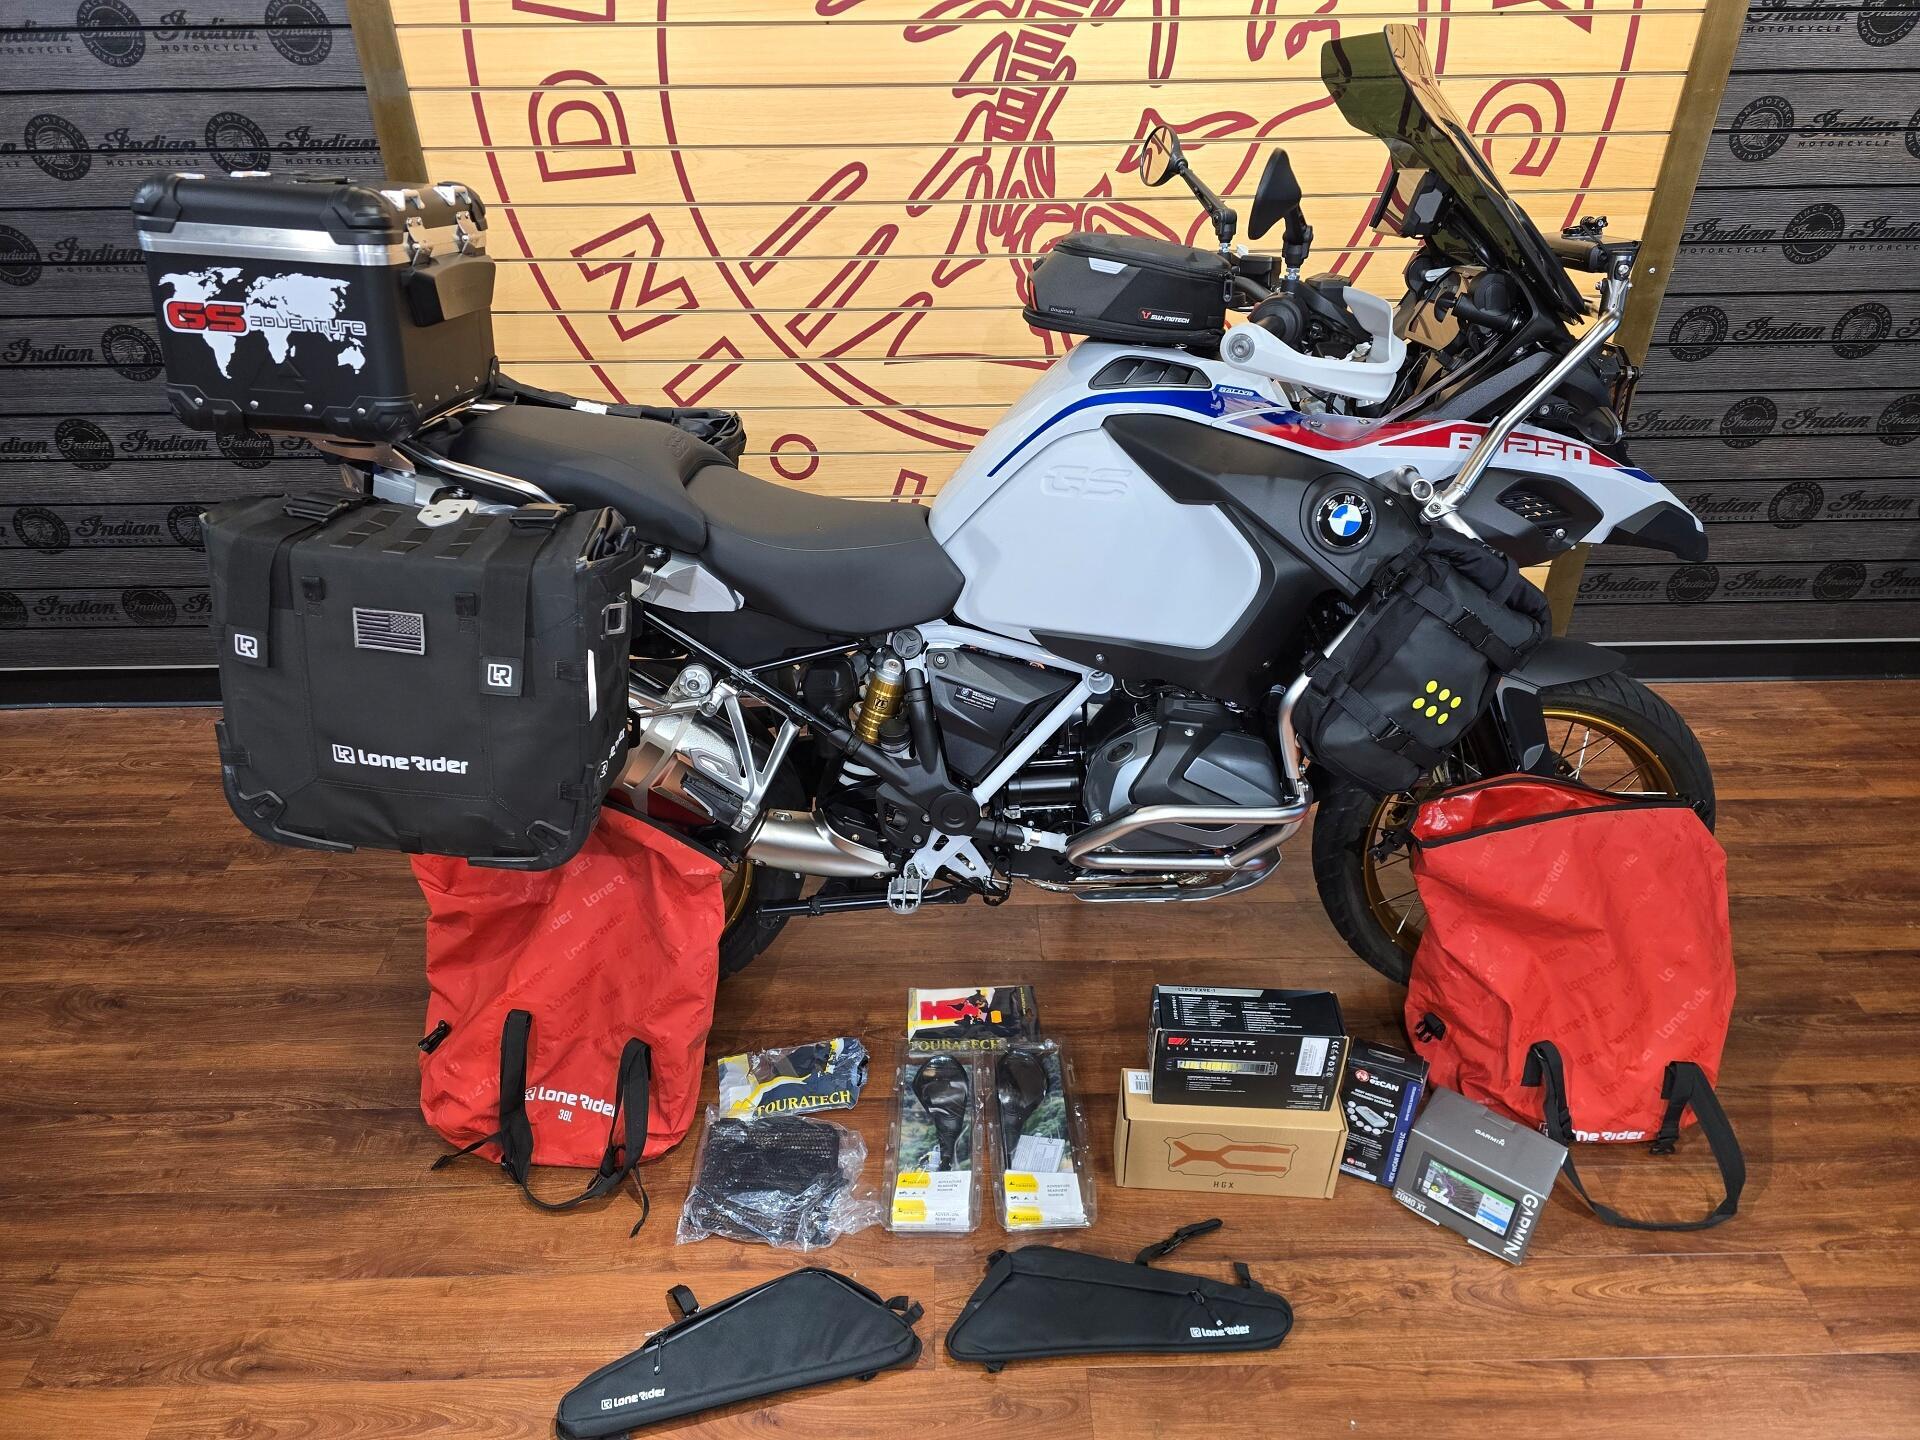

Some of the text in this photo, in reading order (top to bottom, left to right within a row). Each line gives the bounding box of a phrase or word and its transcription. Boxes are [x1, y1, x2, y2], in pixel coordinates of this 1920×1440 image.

[160, 44, 259, 52] MOTORCYCLE
[1797, 109, 1900, 138] Indian
[98, 128, 197, 156] Indian
[278, 126, 378, 155] Indian
[1681, 218, 1777, 241] Indian
[1784, 225, 1841, 239] Indian
[48, 238, 143, 262] Indian
[166, 300, 248, 333] GS
[1150, 314, 1190, 324] SW-MOTECH
[1732, 317, 1825, 341] Indian
[3, 339, 94, 362] Indian
[1626, 410, 1713, 432] Indian
[1722, 416, 1775, 428] Indian
[1782, 407, 1871, 429] Indian
[60, 438, 109, 451] Indian
[120, 430, 208, 452] Indian
[219, 434, 270, 448] Indian
[1040, 465, 1133, 498] GS
[1828, 490, 1914, 512] Indian
[75, 516, 160, 537] Indian
[1579, 573, 1660, 593] Indian
[1724, 570, 1808, 590] Indian
[34, 596, 115, 616] Indian
[537, 1086, 578, 1107] Lone
[756, 1089, 852, 1117] TOURATECH
[558, 1109, 573, 1122] 38L
[1474, 1128, 1505, 1147] GARMIN
[1601, 1130, 1646, 1141] Rider
[1503, 1193, 1539, 1258] GARMIN
